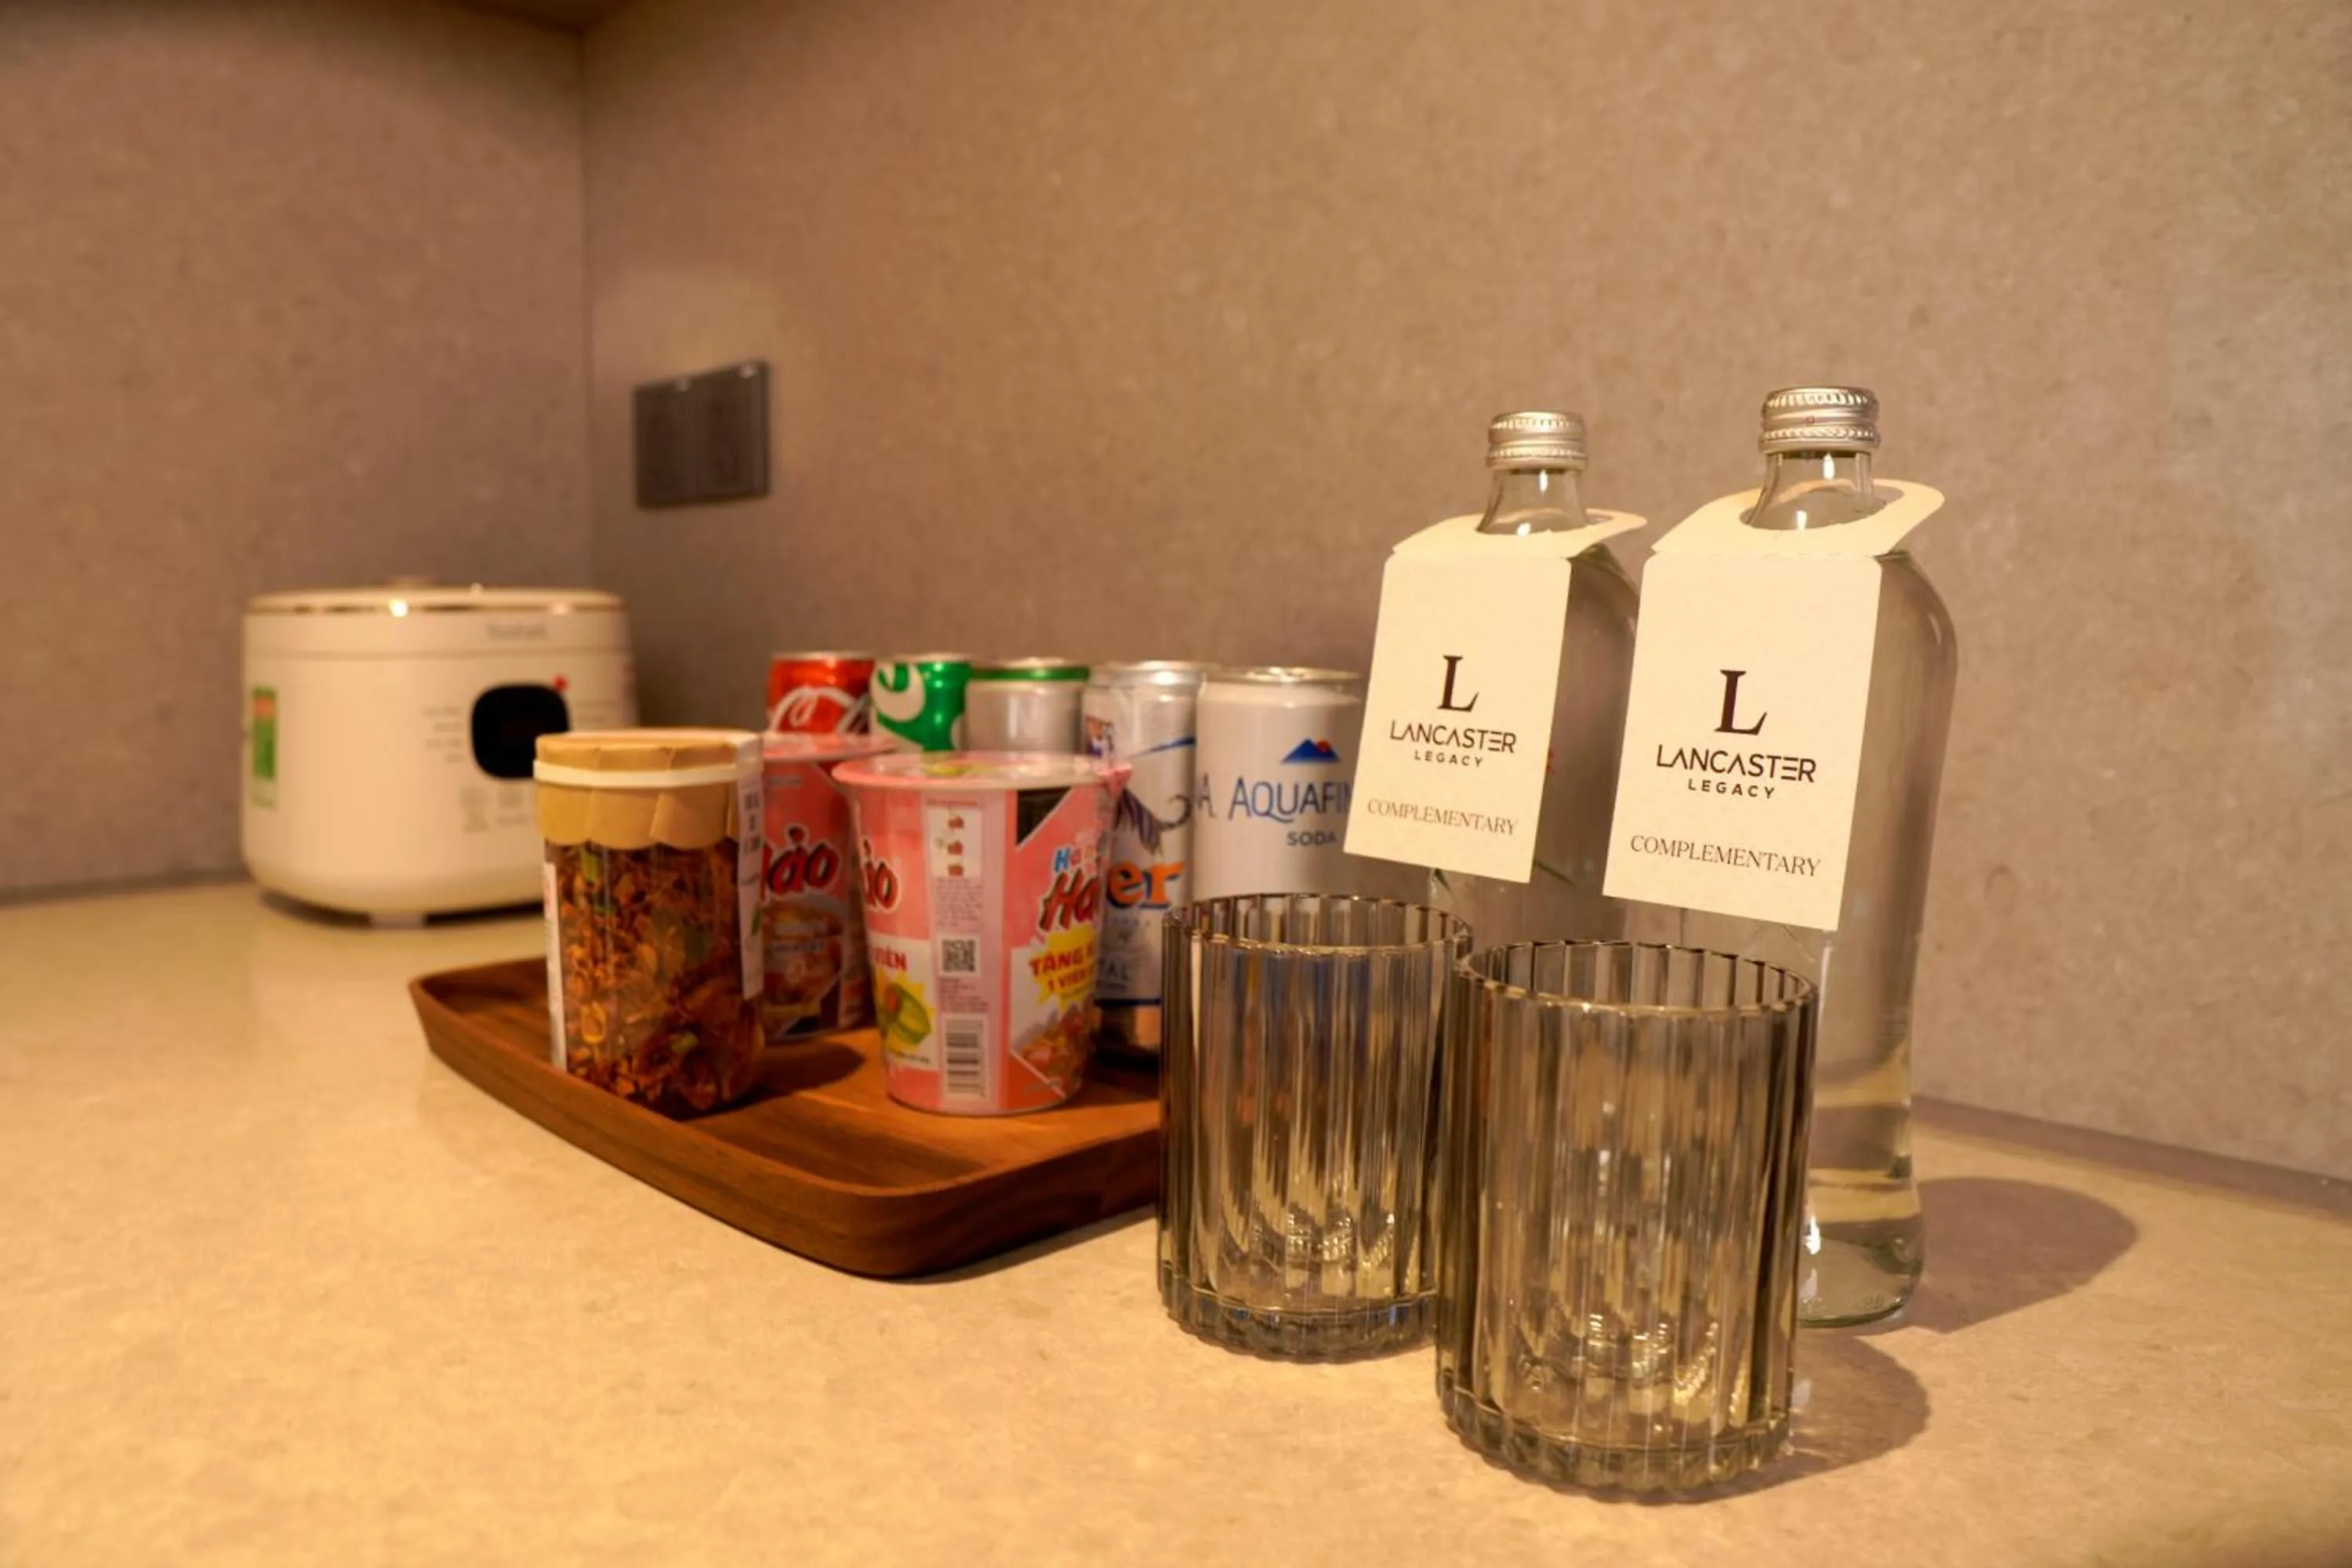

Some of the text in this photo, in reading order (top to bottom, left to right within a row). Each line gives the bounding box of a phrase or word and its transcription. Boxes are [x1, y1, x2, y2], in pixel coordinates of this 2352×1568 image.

[1436, 655, 1479, 713] L
[1714, 670, 1767, 736] L
[1390, 720, 1516, 753] LANCASTER
[1414, 750, 1483, 768] LEGACY
[1657, 743, 1817, 783] LANCASTER
[1688, 779, 1775, 800] LEGACY
[1367, 799, 1519, 837] COMPLEMENTARY
[1287, 832, 1338, 847] SODA
[1630, 835, 1821, 878] COMPLEMENTARY
